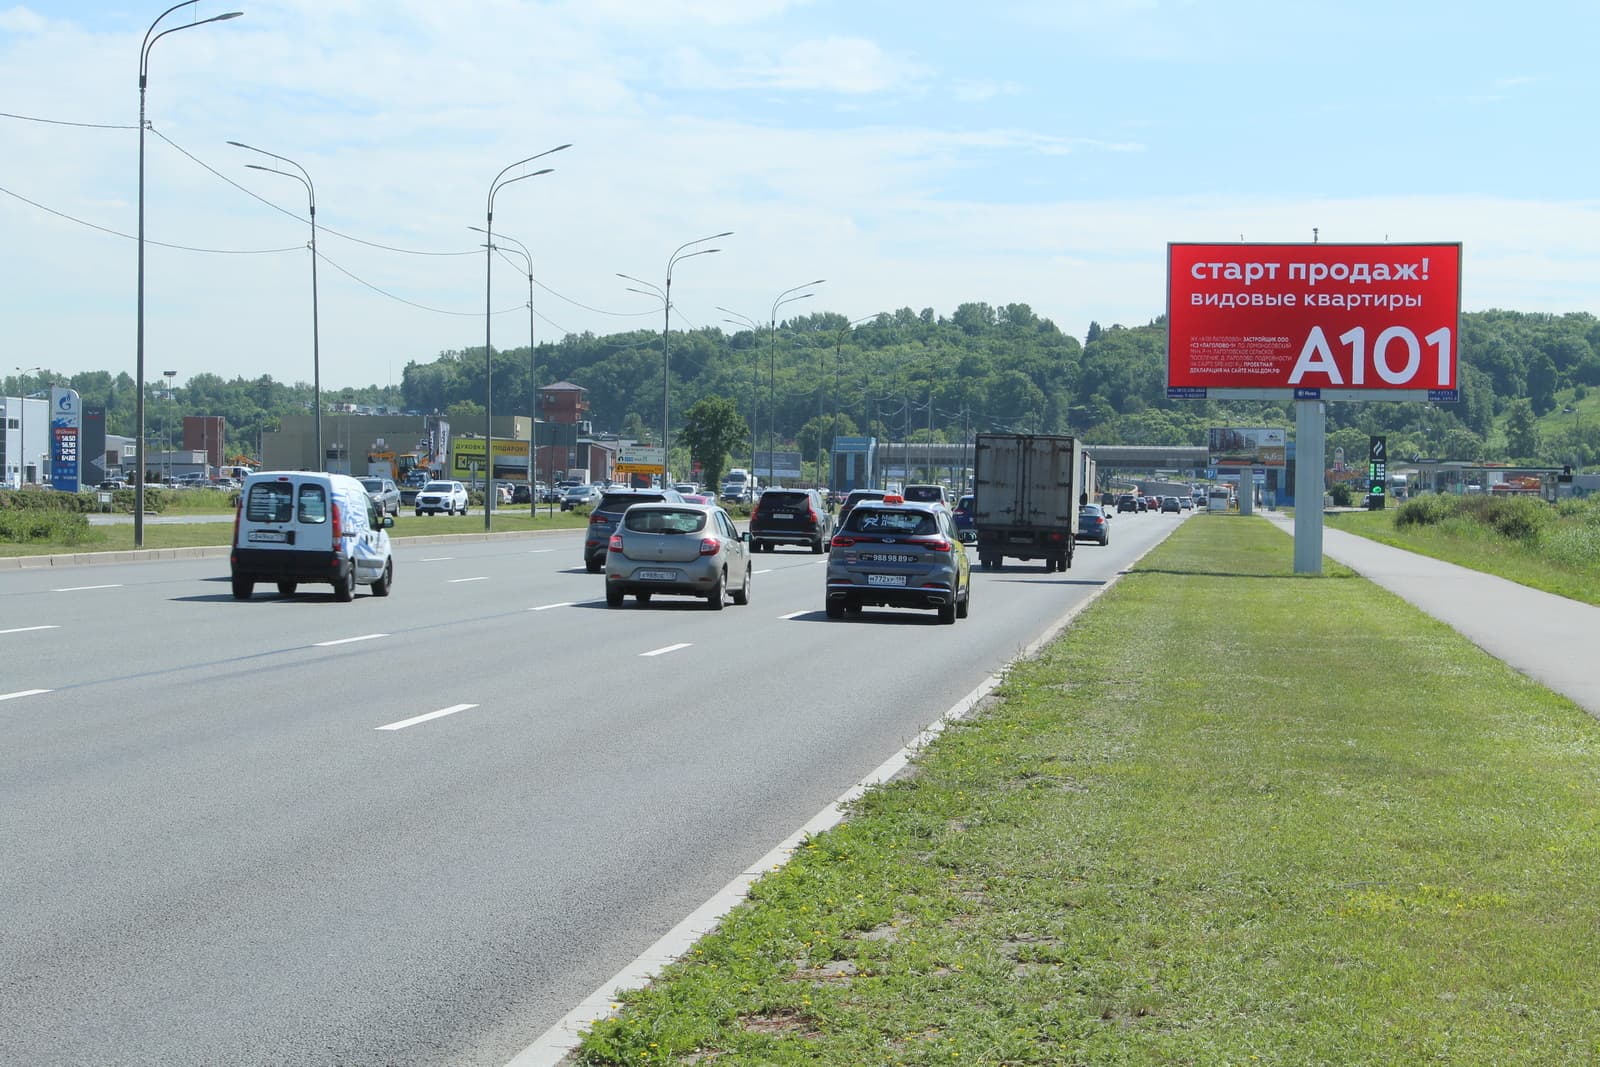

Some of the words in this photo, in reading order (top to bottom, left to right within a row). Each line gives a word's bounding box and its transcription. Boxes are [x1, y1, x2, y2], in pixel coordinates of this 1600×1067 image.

[1191, 262, 1281, 286] старт
[1288, 258, 1429, 285] продаж!
[1191, 293, 1297, 308] видовые
[1304, 293, 1422, 311] квартиры
[1287, 325, 1451, 386] А101
